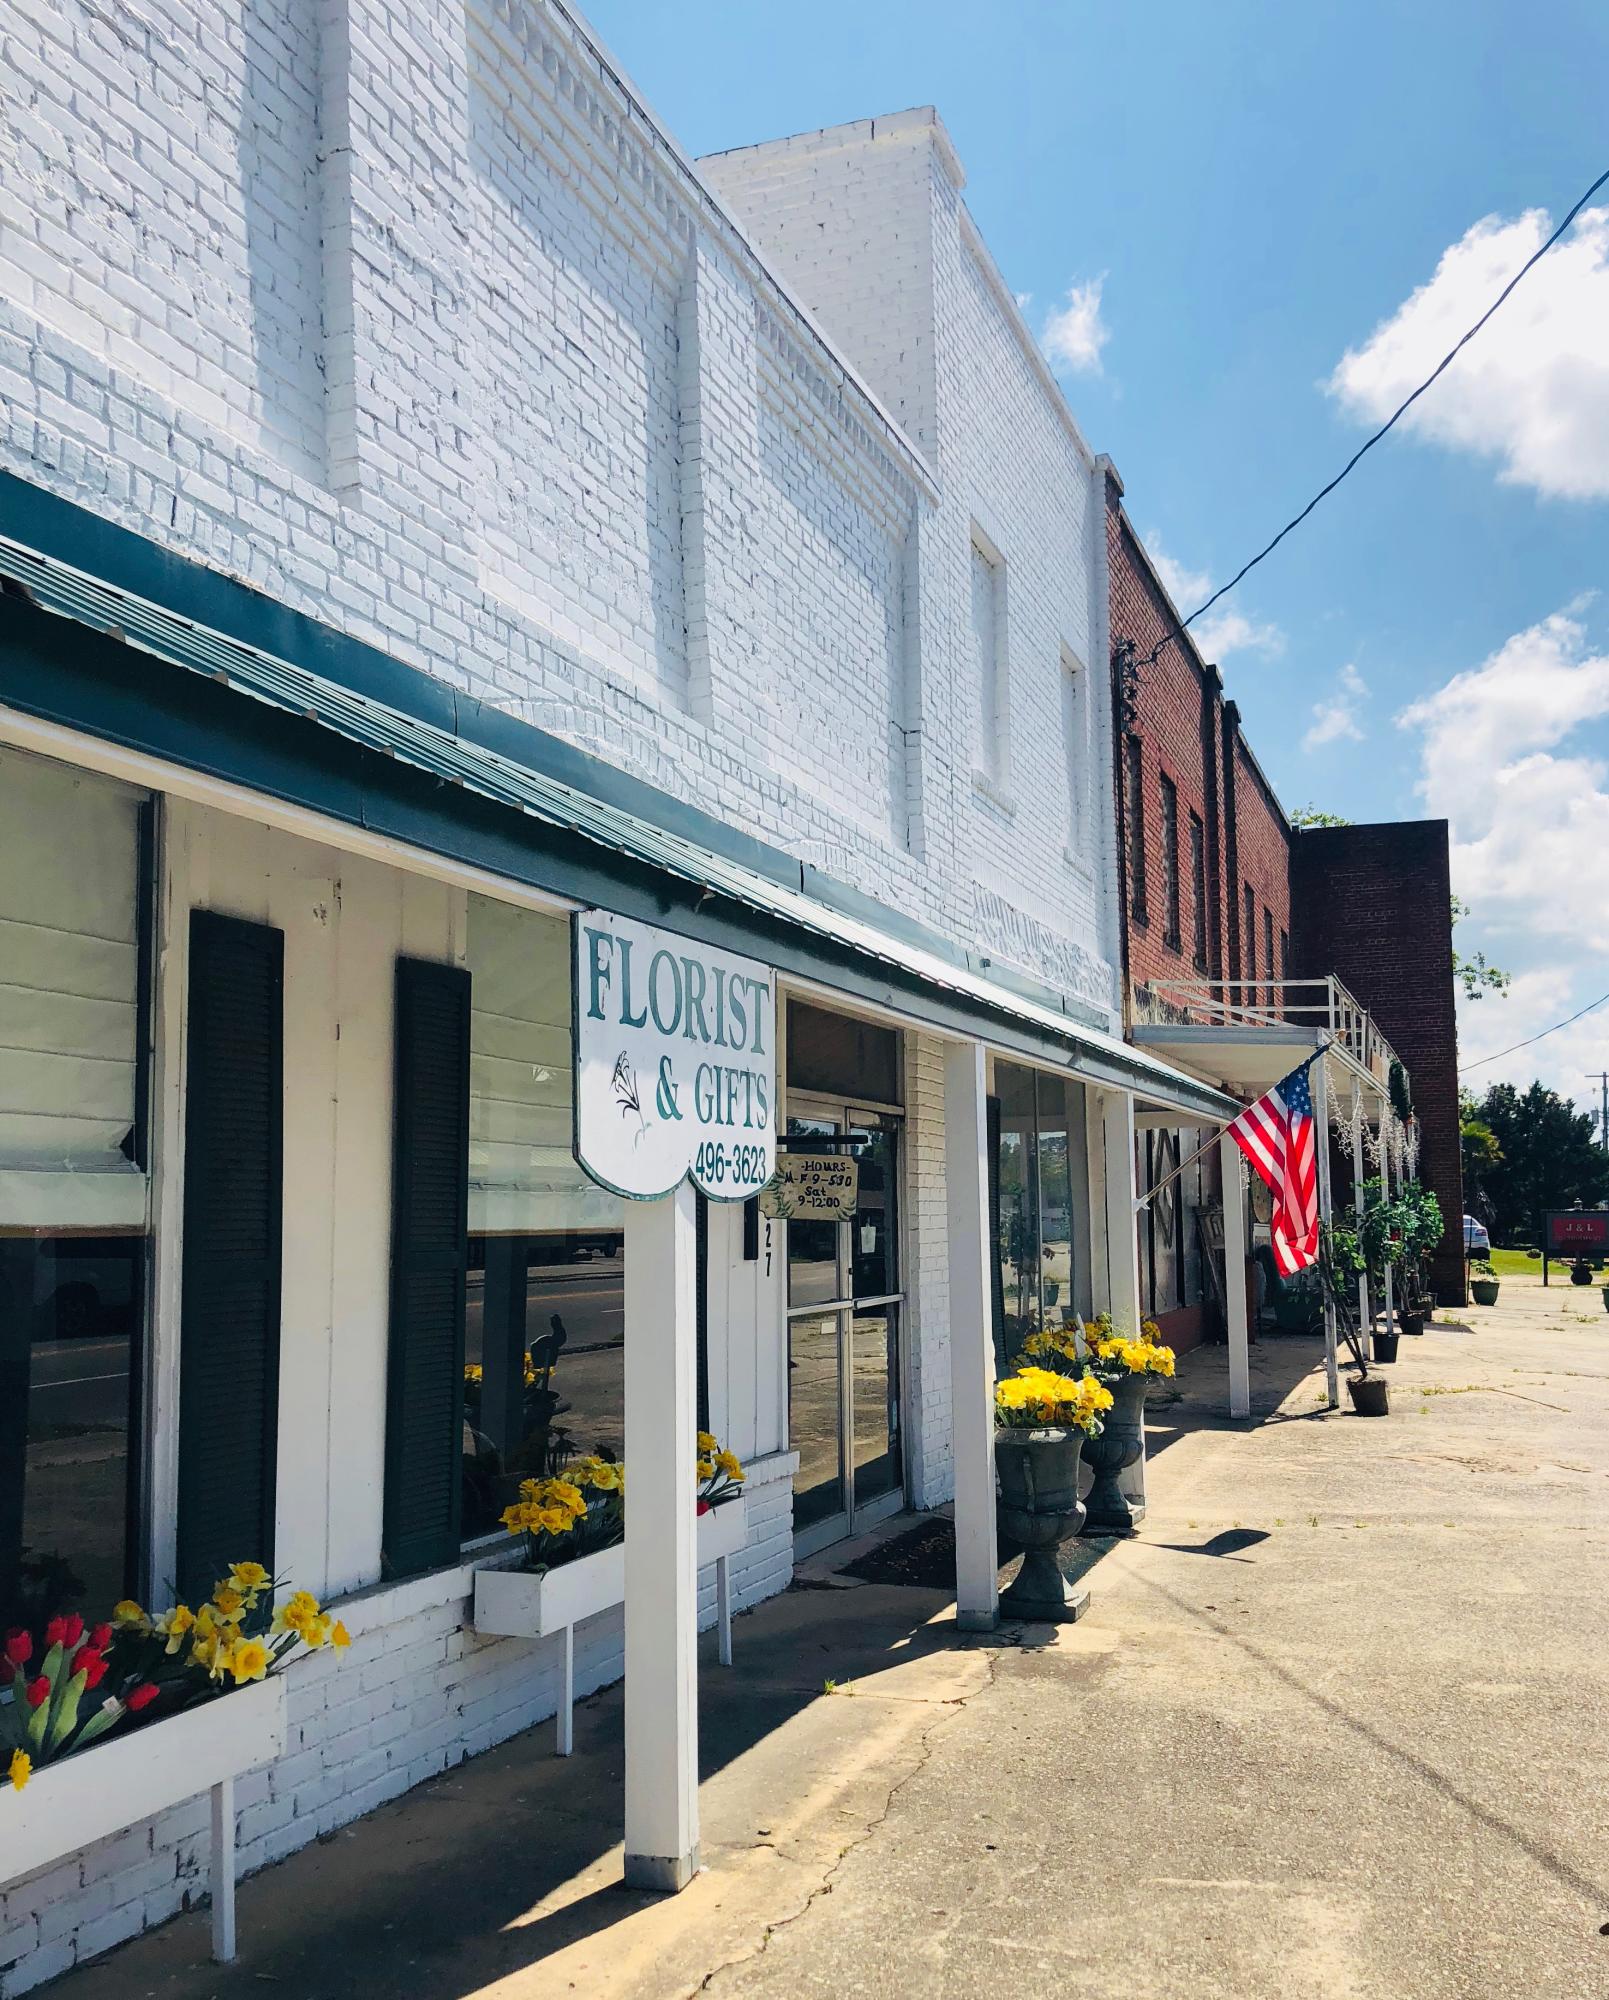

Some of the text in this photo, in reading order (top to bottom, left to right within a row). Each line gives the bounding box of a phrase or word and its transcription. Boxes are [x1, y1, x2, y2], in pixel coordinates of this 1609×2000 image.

[584, 927, 770, 1055] FLORIST
[656, 1055, 768, 1130] & GIFTS
[695, 1141, 766, 1185] 496-3623
[798, 1195, 840, 1208] 9-12:00
[804, 1186, 826, 1196] Sat
[1566, 1223, 1593, 1232] J & L
